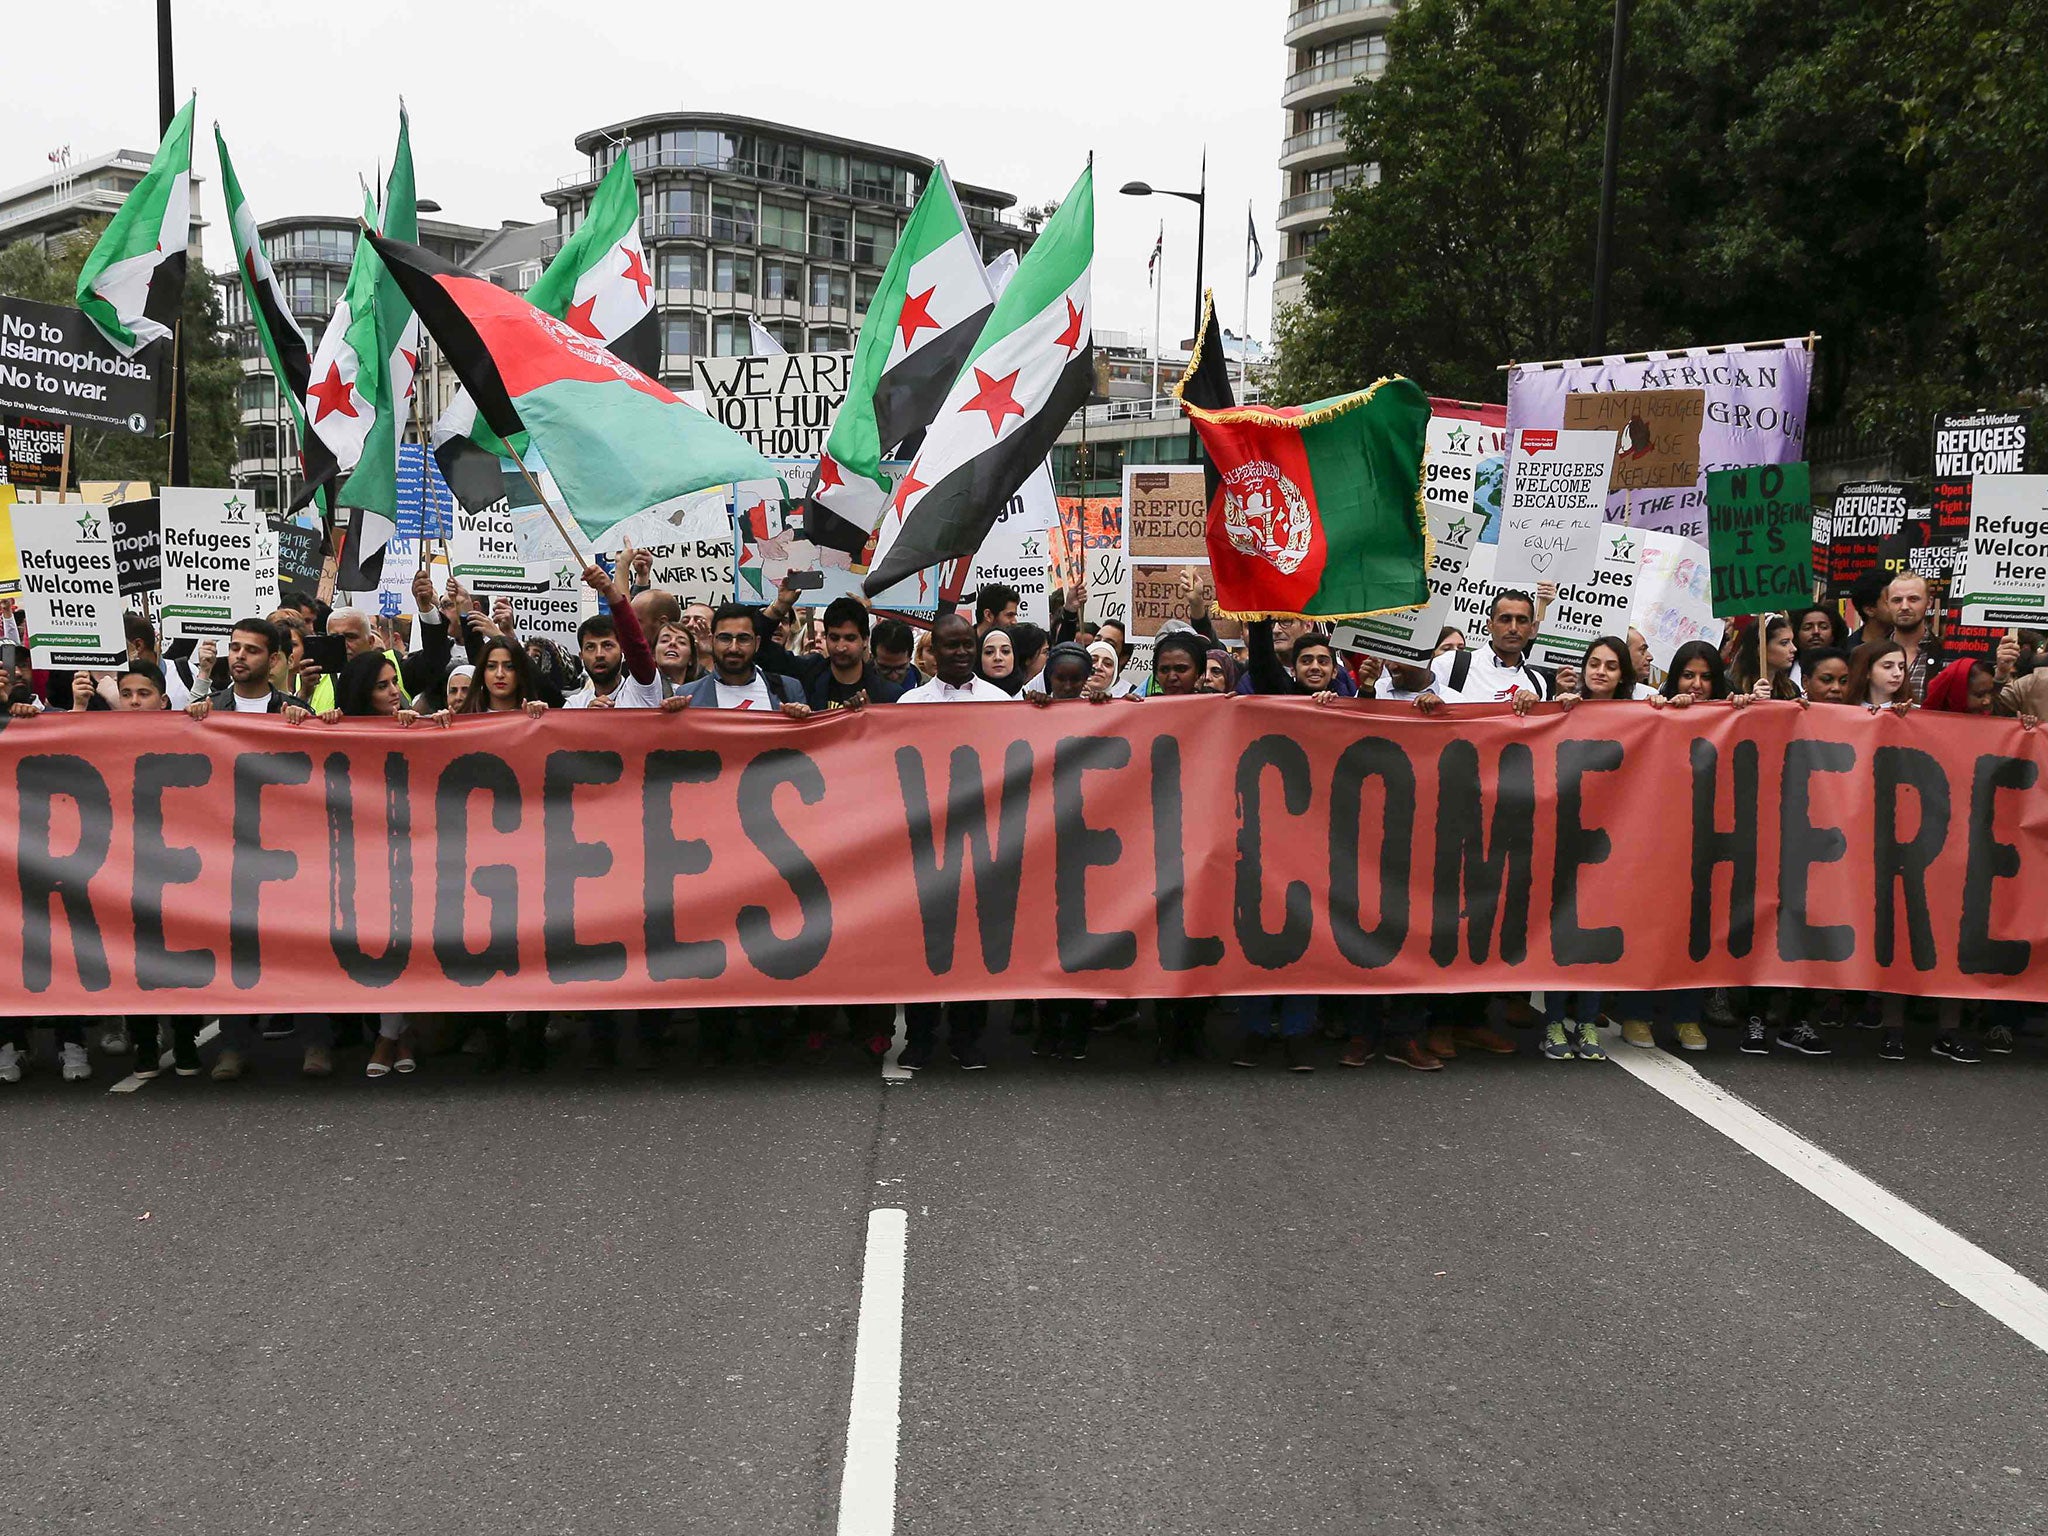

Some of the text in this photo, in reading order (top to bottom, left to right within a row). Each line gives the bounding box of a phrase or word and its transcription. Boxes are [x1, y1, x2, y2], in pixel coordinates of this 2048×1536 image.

[2, 314, 64, 344] No to
[0, 336, 151, 380] Islamophobia.
[0, 364, 107, 402] No to war.
[695, 356, 772, 397] WE
[1642, 366, 1777, 389] AFRICAN
[25, 402, 39, 412] War
[775, 394, 847, 427] HUM
[1647, 399, 1701, 422] REFUGEE
[8, 428, 65, 442] REFUGEE
[740, 428, 832, 455] THOUT
[1937, 426, 2026, 453] REFUGEES
[8, 439, 65, 455] WELCOM
[10, 451, 42, 464] HERE
[1936, 449, 2024, 476] WELCOME
[1427, 463, 1471, 482] gees
[1517, 462, 1604, 477] REFUGEES
[1671, 462, 1692, 483] ME
[1515, 478, 1591, 493] WELCOME
[1732, 464, 1784, 499] NO
[1133, 500, 1205, 517] REFUG
[1512, 493, 1598, 509] BECAUSE...
[1640, 492, 1675, 517] THE
[1834, 496, 1907, 517] REFUGEES
[459, 516, 514, 533] Welco
[1509, 518, 1592, 529] WE ARE ALL
[1709, 500, 1813, 532] HUMAN BEING
[1680, 521, 1703, 536] BE
[1975, 515, 2048, 539] Refuge
[165, 528, 250, 551] Refugees
[1524, 535, 1577, 552] EQUAL
[1736, 527, 1787, 555] IS
[21, 549, 111, 574] Refugees
[166, 551, 250, 571] Welcome
[682, 546, 690, 557] IN
[1909, 547, 1957, 558] REFUGE
[133, 554, 160, 571] wa
[1996, 561, 2047, 579] Here
[25, 574, 114, 594] Welcome
[186, 573, 230, 592] Here
[653, 567, 718, 583] WATER IS
[1711, 563, 1814, 603] ILLEGAL
[1993, 580, 2046, 589] #SafePassage
[1555, 583, 1629, 609] elcome
[50, 599, 96, 618] Here
[1558, 605, 1603, 627] Here
[1988, 612, 2048, 622] info@syriasolidarity.org
[51, 619, 98, 627] #SafePassage
[15, 733, 2040, 993] REFUGEES WELCOME HERE
